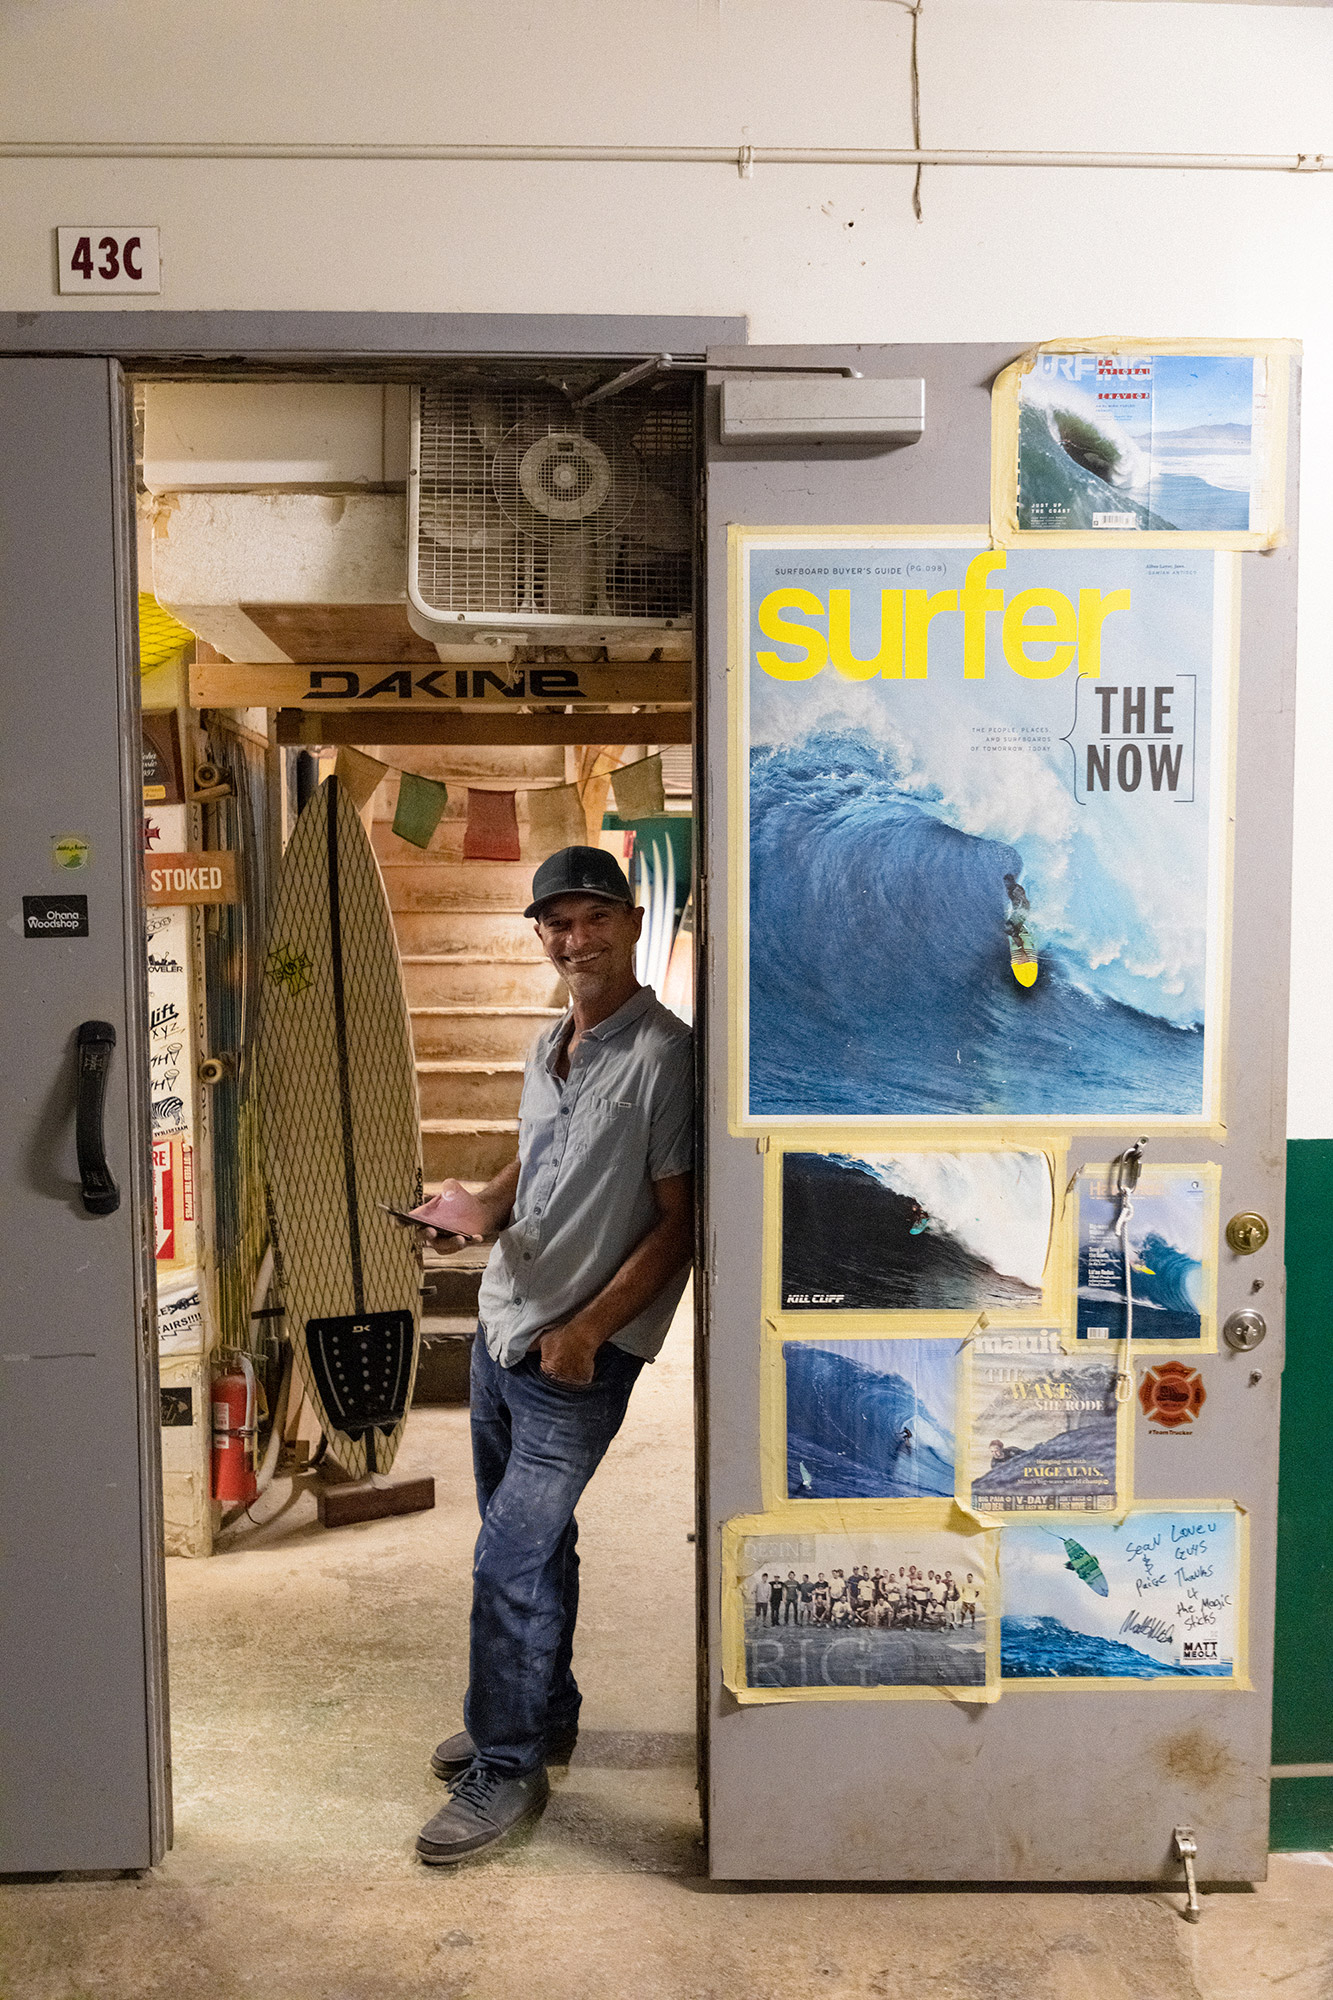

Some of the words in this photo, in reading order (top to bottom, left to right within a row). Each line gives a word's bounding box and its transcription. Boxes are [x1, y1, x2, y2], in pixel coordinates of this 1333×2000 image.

[71, 236, 142, 280] 43C
[775, 567, 830, 576] SURFBOARD
[832, 567, 872, 575] BUYER'S
[874, 567, 902, 575] GUIDE
[755, 551, 1131, 681] surfer
[301, 670, 587, 699] DAKINE
[1095, 686, 1174, 734] THE
[1086, 743, 1183, 792] NOW
[150, 867, 222, 892] STOKED
[46, 910, 79, 920] Ohana
[27, 916, 79, 930] Woodshop
[184, 1152, 193, 1165] NOT
[184, 1166, 193, 1181] FEED
[184, 1181, 193, 1193] THE
[787, 1294, 811, 1303] KILL
[812, 1294, 845, 1303] CLIFF
[985, 1367, 1025, 1383] THE
[1010, 1383, 1072, 1400] WAVE
[1035, 1401, 1062, 1411] SHE
[1066, 1400, 1105, 1411] RODE
[1024, 1467, 1062, 1477] PAIGE
[1064, 1467, 1104, 1477] ALMS.
[1016, 1496, 1048, 1505] V-DAY
[1184, 1641, 1218, 1650] MATT
[1184, 1650, 1218, 1658] MEOLA
